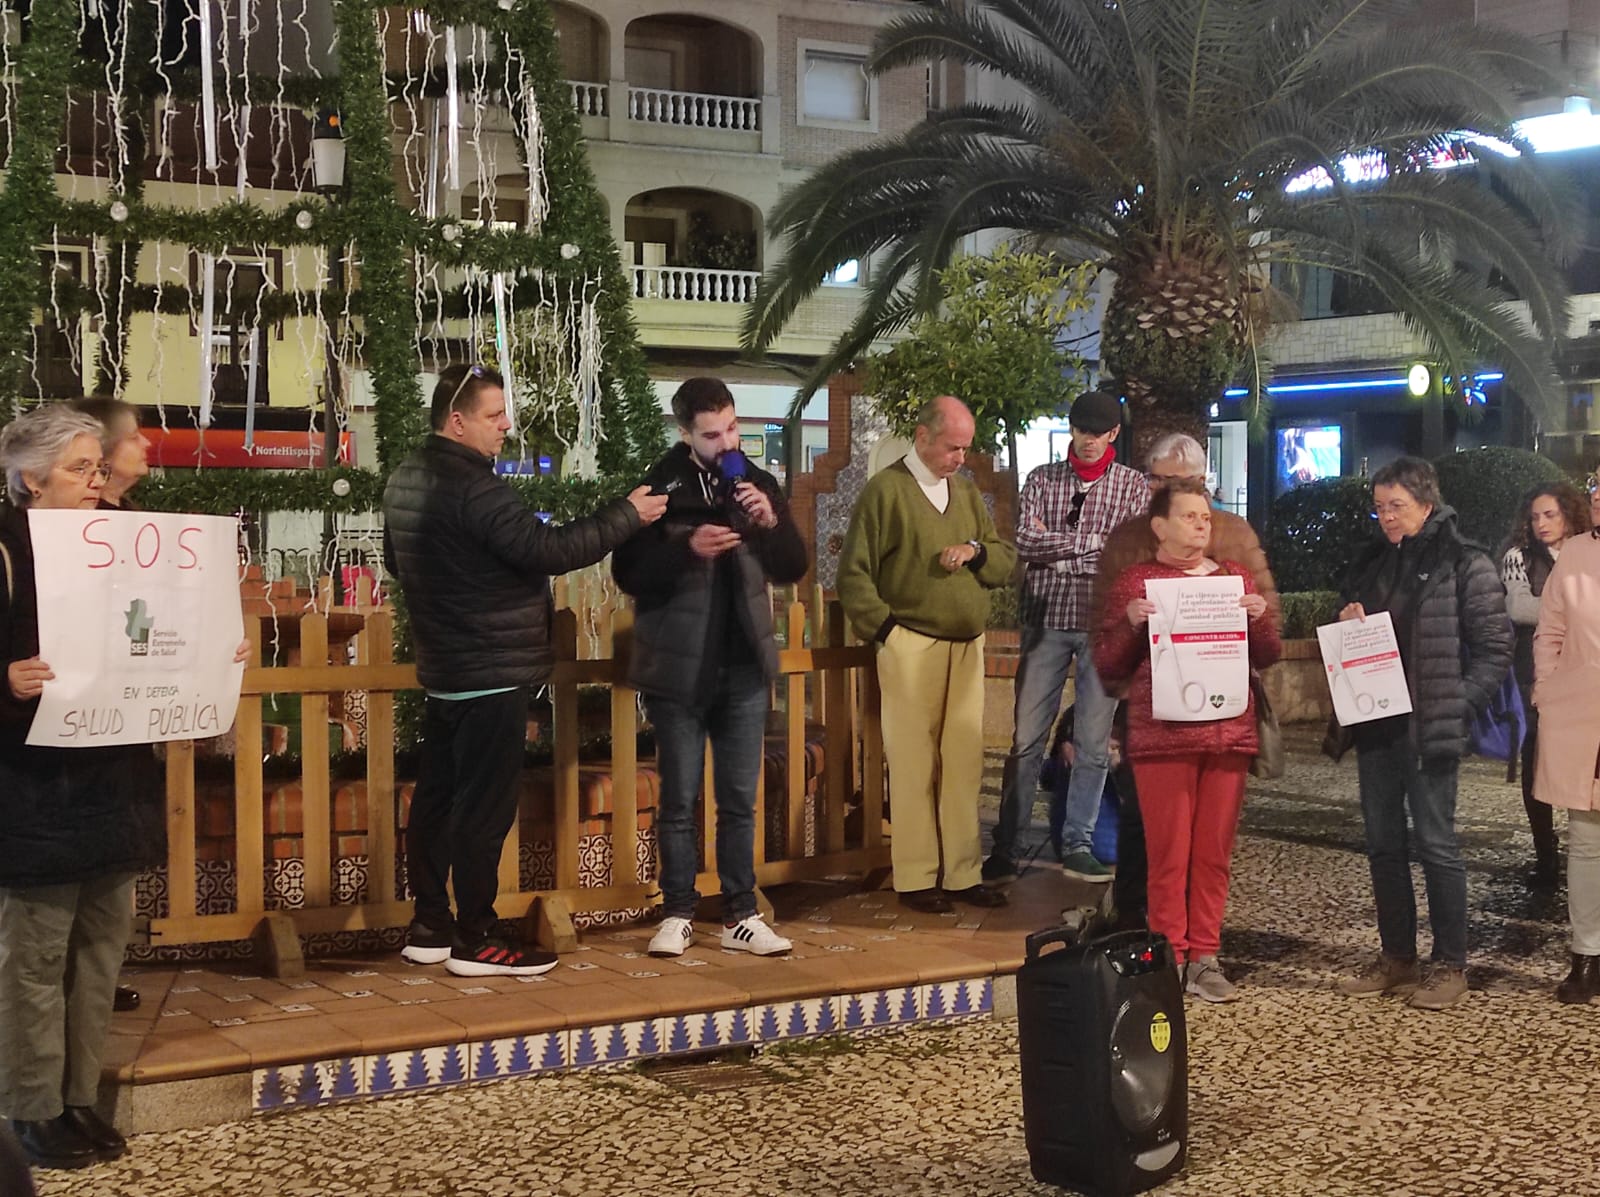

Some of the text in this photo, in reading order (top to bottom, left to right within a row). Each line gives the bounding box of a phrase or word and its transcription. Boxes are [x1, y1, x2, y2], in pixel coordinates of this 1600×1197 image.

[131, 642, 148, 654] SES
[123, 686, 140, 700] EN
[58, 708, 124, 740] SALUD
